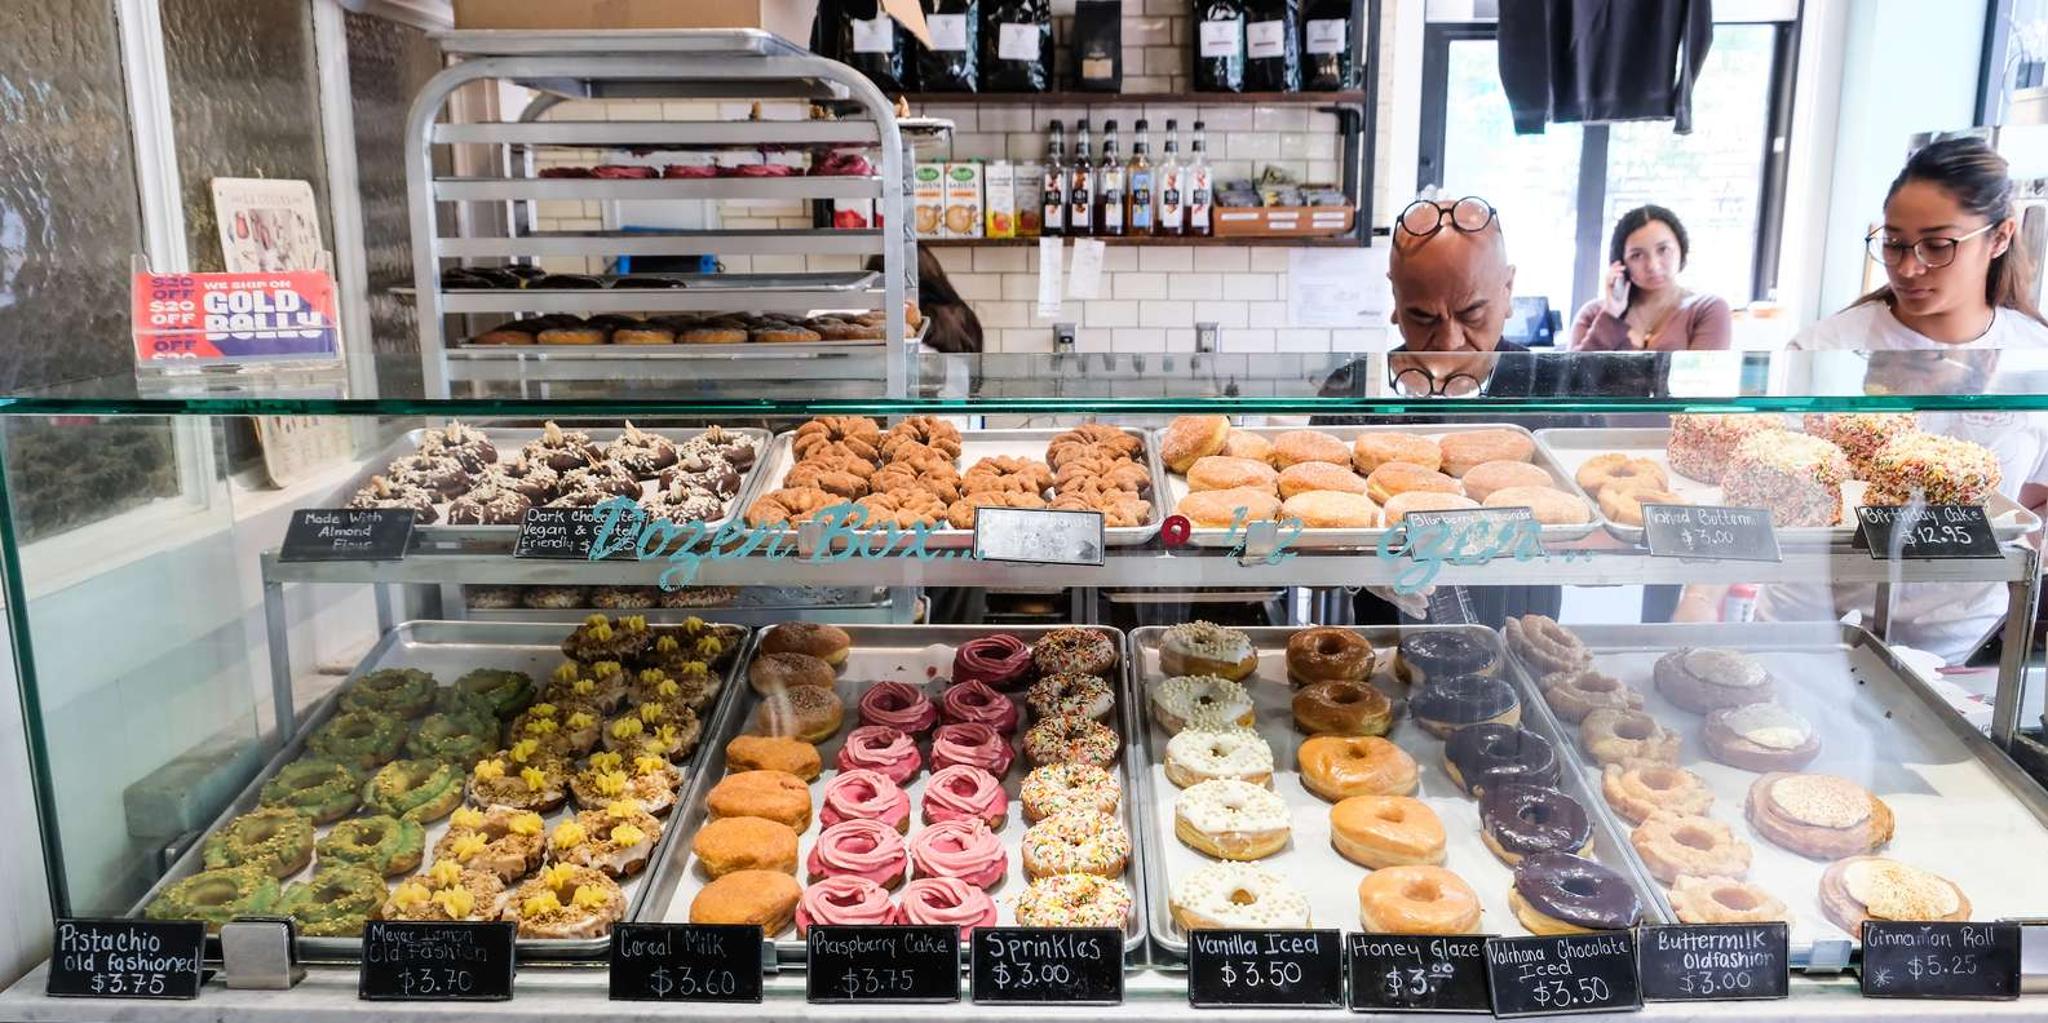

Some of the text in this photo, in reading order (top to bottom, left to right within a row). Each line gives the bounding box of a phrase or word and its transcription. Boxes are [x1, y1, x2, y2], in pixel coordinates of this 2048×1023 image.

[153, 289, 193, 300] OFF
[204, 281, 228, 289] WE
[203, 289, 300, 314] GOLD
[151, 314, 195, 326] OFF
[154, 340, 196, 351] OFF
[305, 511, 383, 525] Made With
[528, 508, 635, 523] Dark Chocote
[1865, 506, 1982, 527] Birthday Cake
[318, 524, 373, 538] Almond
[523, 522, 567, 539] Vegan
[574, 524, 588, 536] &
[587, 493, 794, 593] Dozen
[1901, 525, 1973, 548] $12.95
[521, 535, 574, 552] Friendly
[59, 924, 160, 952] Pistachio
[620, 929, 727, 958] Cereal Milk
[812, 930, 949, 959] Raspberry Cake
[986, 931, 1101, 963] Sprinkles
[1196, 933, 1320, 955] Vanilla Iced
[1658, 930, 1767, 951] Buttermilk
[1867, 925, 1996, 948] Cinnamon Roll
[64, 946, 198, 974] old fashioned
[1352, 938, 1481, 965] Honey Glaze
[1488, 937, 1629, 965] Valrhona Chocolate
[992, 962, 1070, 989] $3.00
[1220, 961, 1302, 988] $3.50
[1518, 959, 1573, 983] Iced
[1907, 954, 1978, 980] $5.25
[91, 973, 166, 993] $3.75
[398, 967, 473, 994] $3.70
[650, 965, 736, 997] $3.60
[841, 967, 915, 999] $3.75
[1533, 976, 1610, 1007] $3.50
[1679, 970, 1752, 995] $3.00
